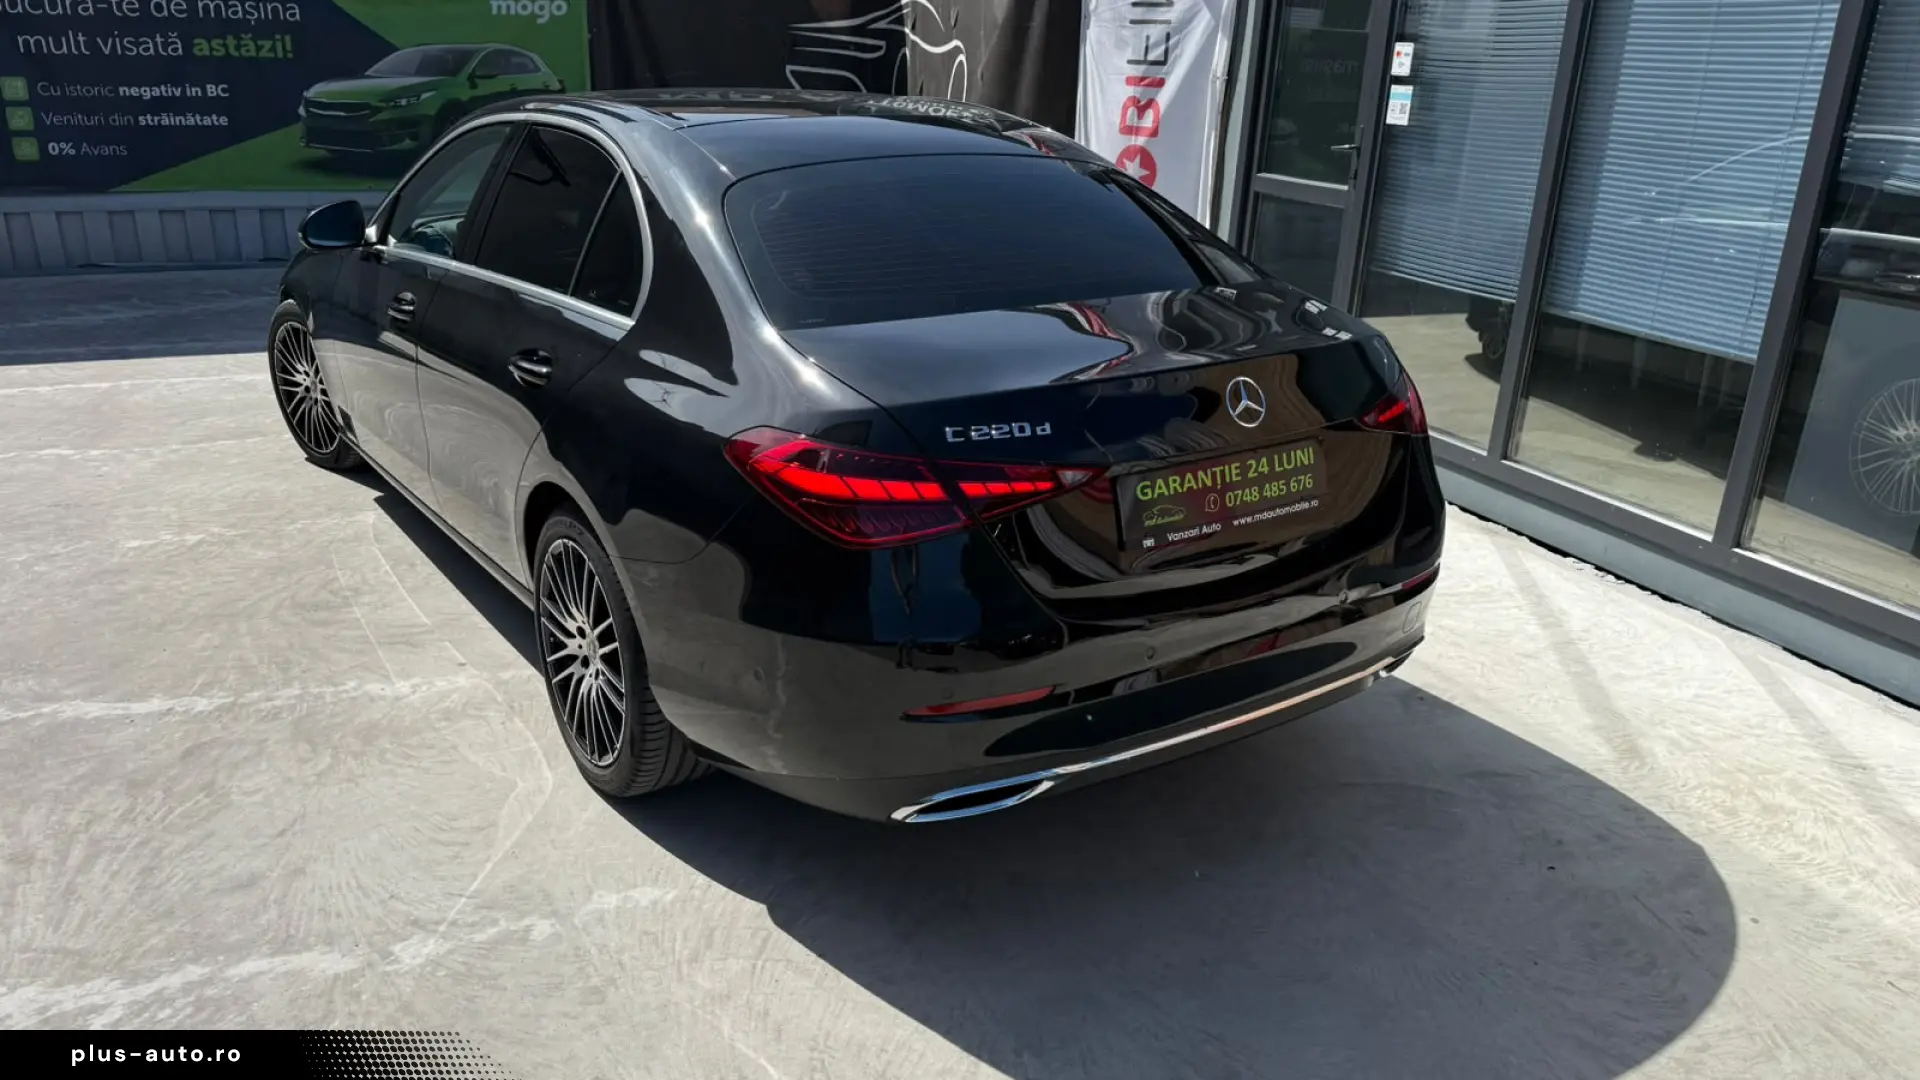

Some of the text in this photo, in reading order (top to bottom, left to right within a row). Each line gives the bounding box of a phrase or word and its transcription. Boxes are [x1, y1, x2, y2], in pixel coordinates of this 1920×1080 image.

[150, 0, 188, 18] de
[490, 0, 568, 24] mogo
[17, 30, 294, 59] mult visată astăzi!
[37, 82, 61, 96] Cu
[64, 82, 115, 97] istoric
[118, 83, 181, 99] negativ
[206, 84, 229, 97] BC
[41, 112, 229, 126] Venituri din străinătate
[48, 142, 128, 155] 0% Avans
[945, 422, 1051, 442] C 220 d
[1136, 447, 1315, 501] GARANȚIE 24 LUNI
[1225, 473, 1314, 508] 0748 485 676
[1232, 499, 1319, 527] www.mdautomobile.ro
[1167, 521, 1222, 542] Vanzari Auto
